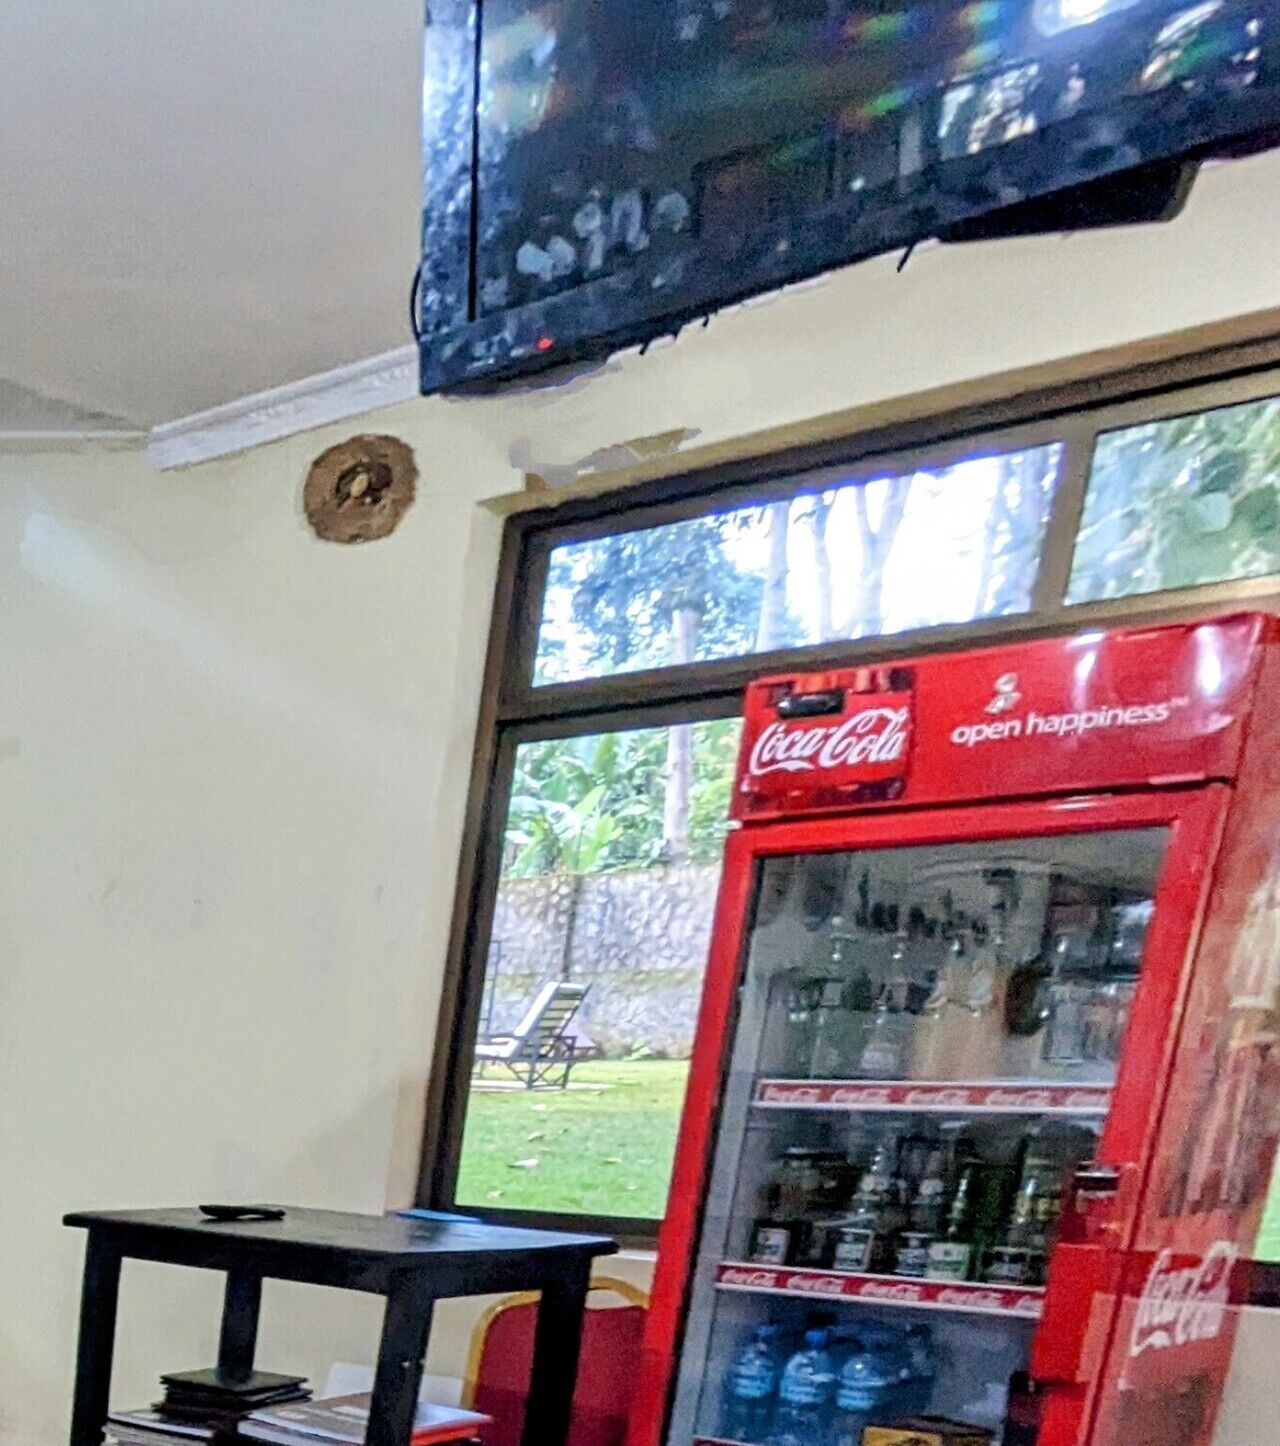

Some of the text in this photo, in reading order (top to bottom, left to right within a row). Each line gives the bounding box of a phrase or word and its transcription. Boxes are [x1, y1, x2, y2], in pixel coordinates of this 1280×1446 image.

[748, 706, 909, 776] Coca-Cola
[950, 702, 1170, 747] open happiness
